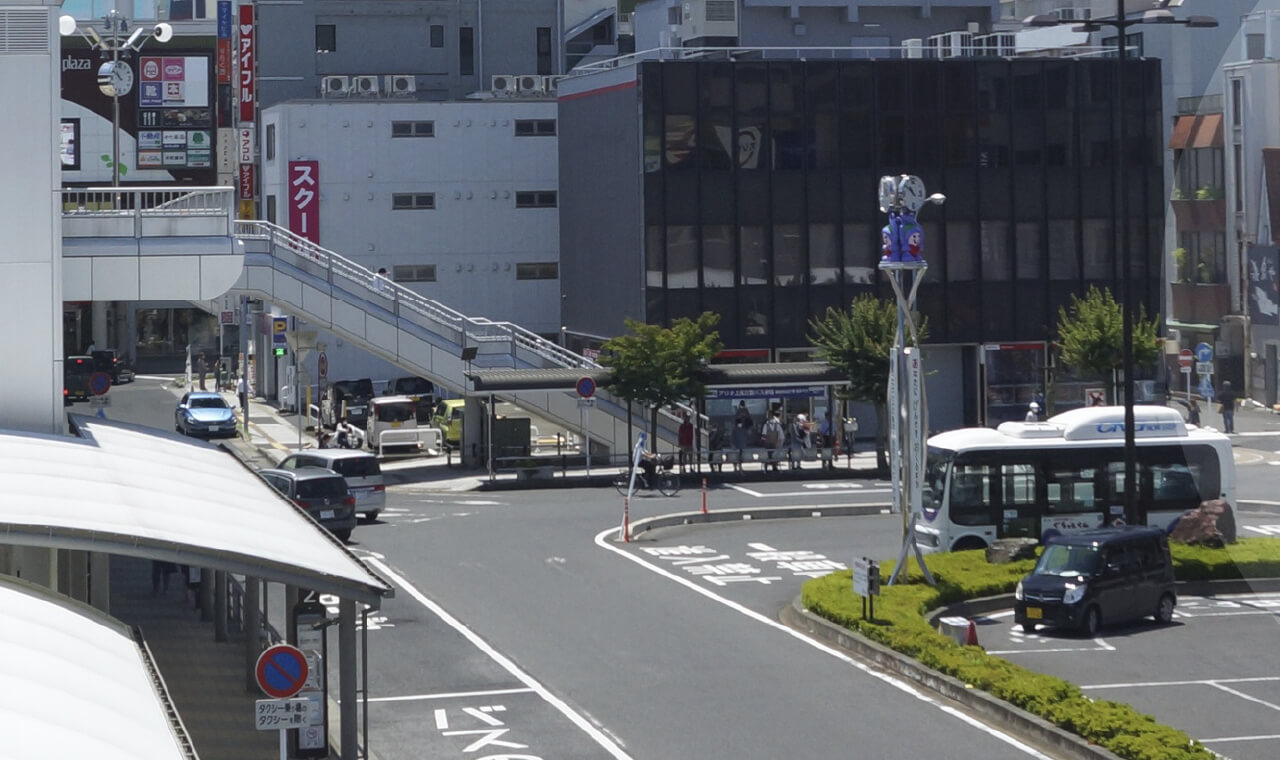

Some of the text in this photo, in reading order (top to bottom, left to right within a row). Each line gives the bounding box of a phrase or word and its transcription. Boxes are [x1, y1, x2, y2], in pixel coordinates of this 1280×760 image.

[62, 55, 91, 71] plaza
[241, 39, 253, 102] アイフル
[293, 166, 315, 250] スクー
[275, 321, 286, 335] P
